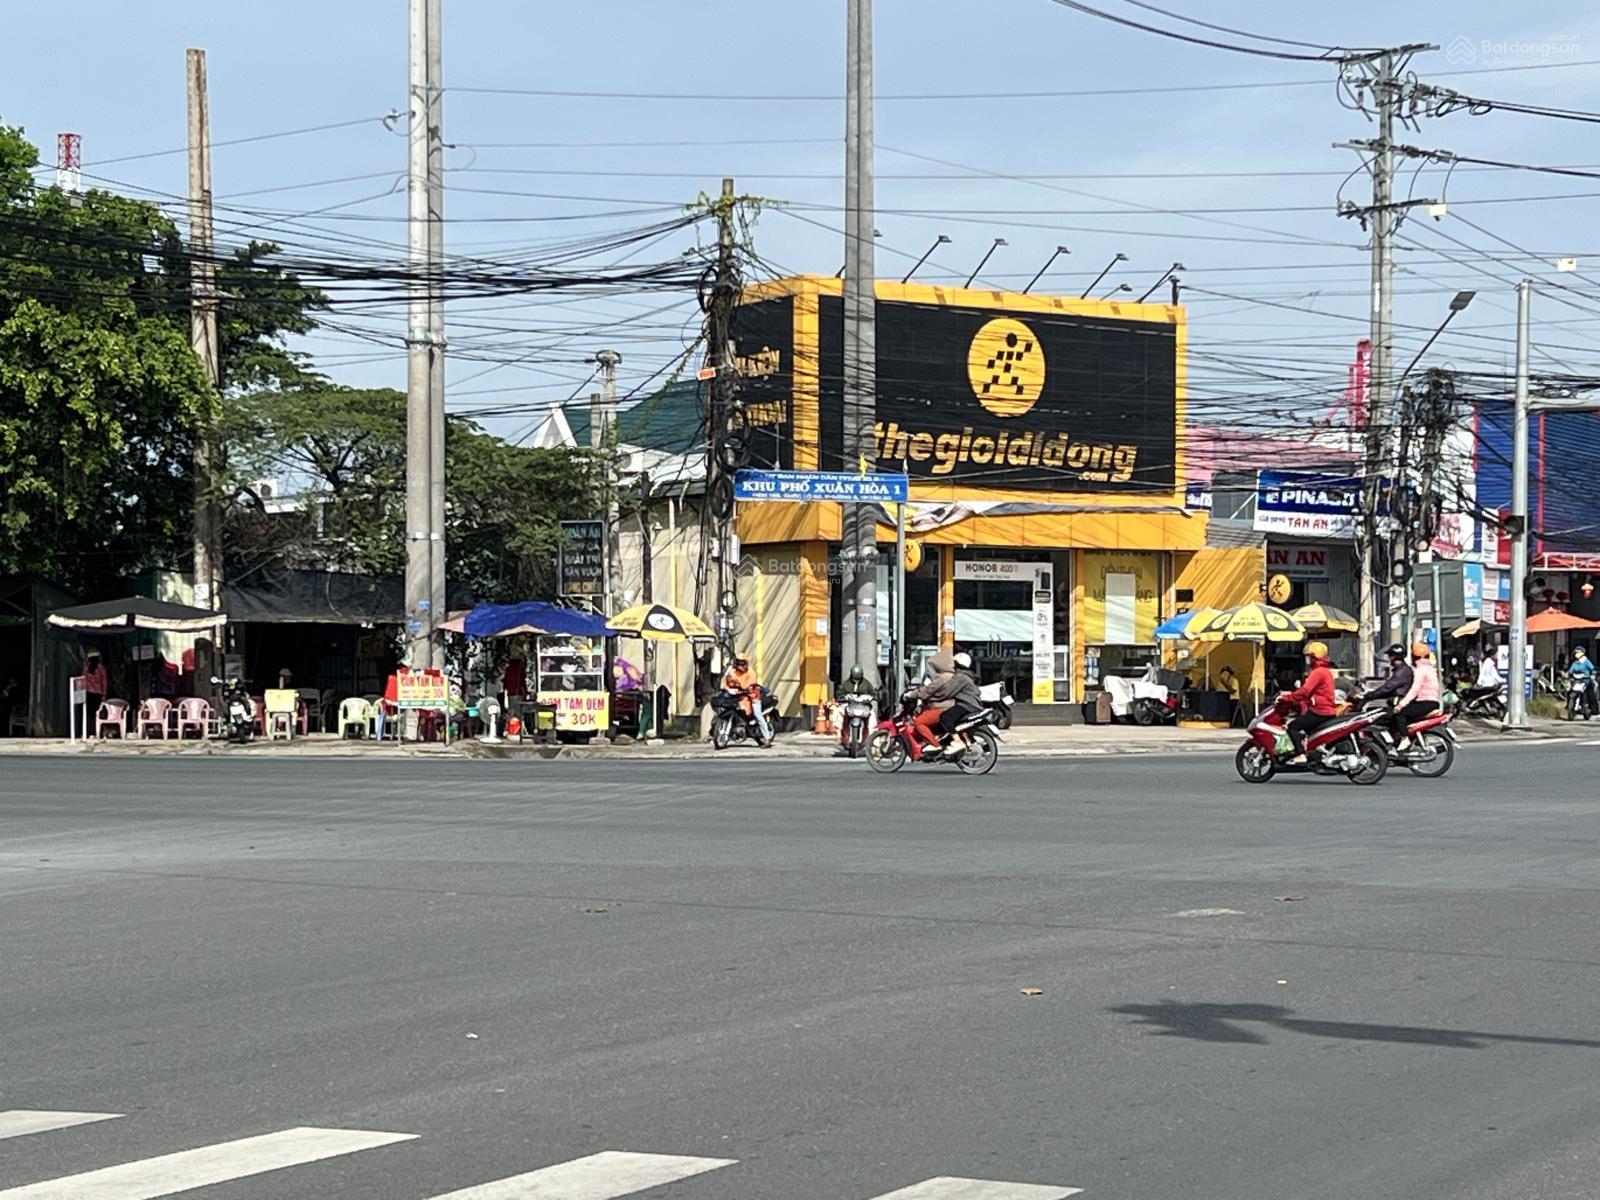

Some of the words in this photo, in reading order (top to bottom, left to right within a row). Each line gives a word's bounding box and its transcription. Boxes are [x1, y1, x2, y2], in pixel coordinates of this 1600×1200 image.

[742, 480, 775, 492] KHU
[780, 479, 811, 493] PHỐ
[815, 480, 855, 494] XUÂN
[859, 482, 890, 496] HÒA
[894, 484, 901, 496] 1
[965, 563, 998, 573] HONOR
[571, 712, 596, 726] 30K
